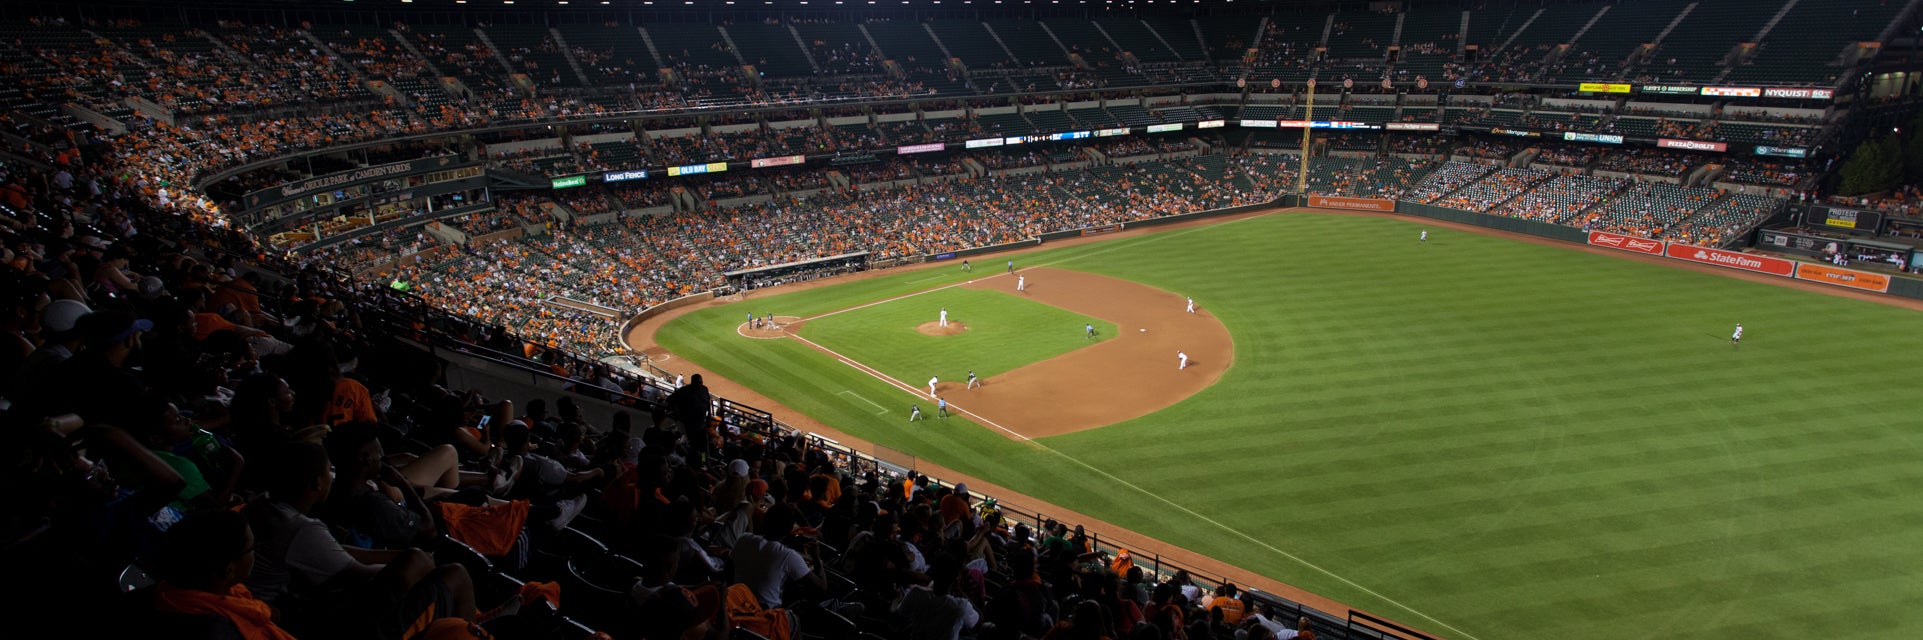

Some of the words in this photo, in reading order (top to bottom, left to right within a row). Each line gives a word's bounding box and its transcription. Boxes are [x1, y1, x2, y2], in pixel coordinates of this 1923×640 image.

[1764, 89, 1808, 97] NYQUIST
[1599, 134, 1624, 143] UNION
[681, 165, 694, 175] OLD
[693, 164, 706, 173] BAY
[304, 177, 330, 191] ORIOLE
[329, 174, 350, 186] PARK
[355, 166, 387, 180] CAMDEN
[386, 162, 411, 174] YARDS
[606, 173, 624, 181] LONG
[625, 171, 645, 179] FENCE
[1829, 207, 1859, 217] PROTECT
